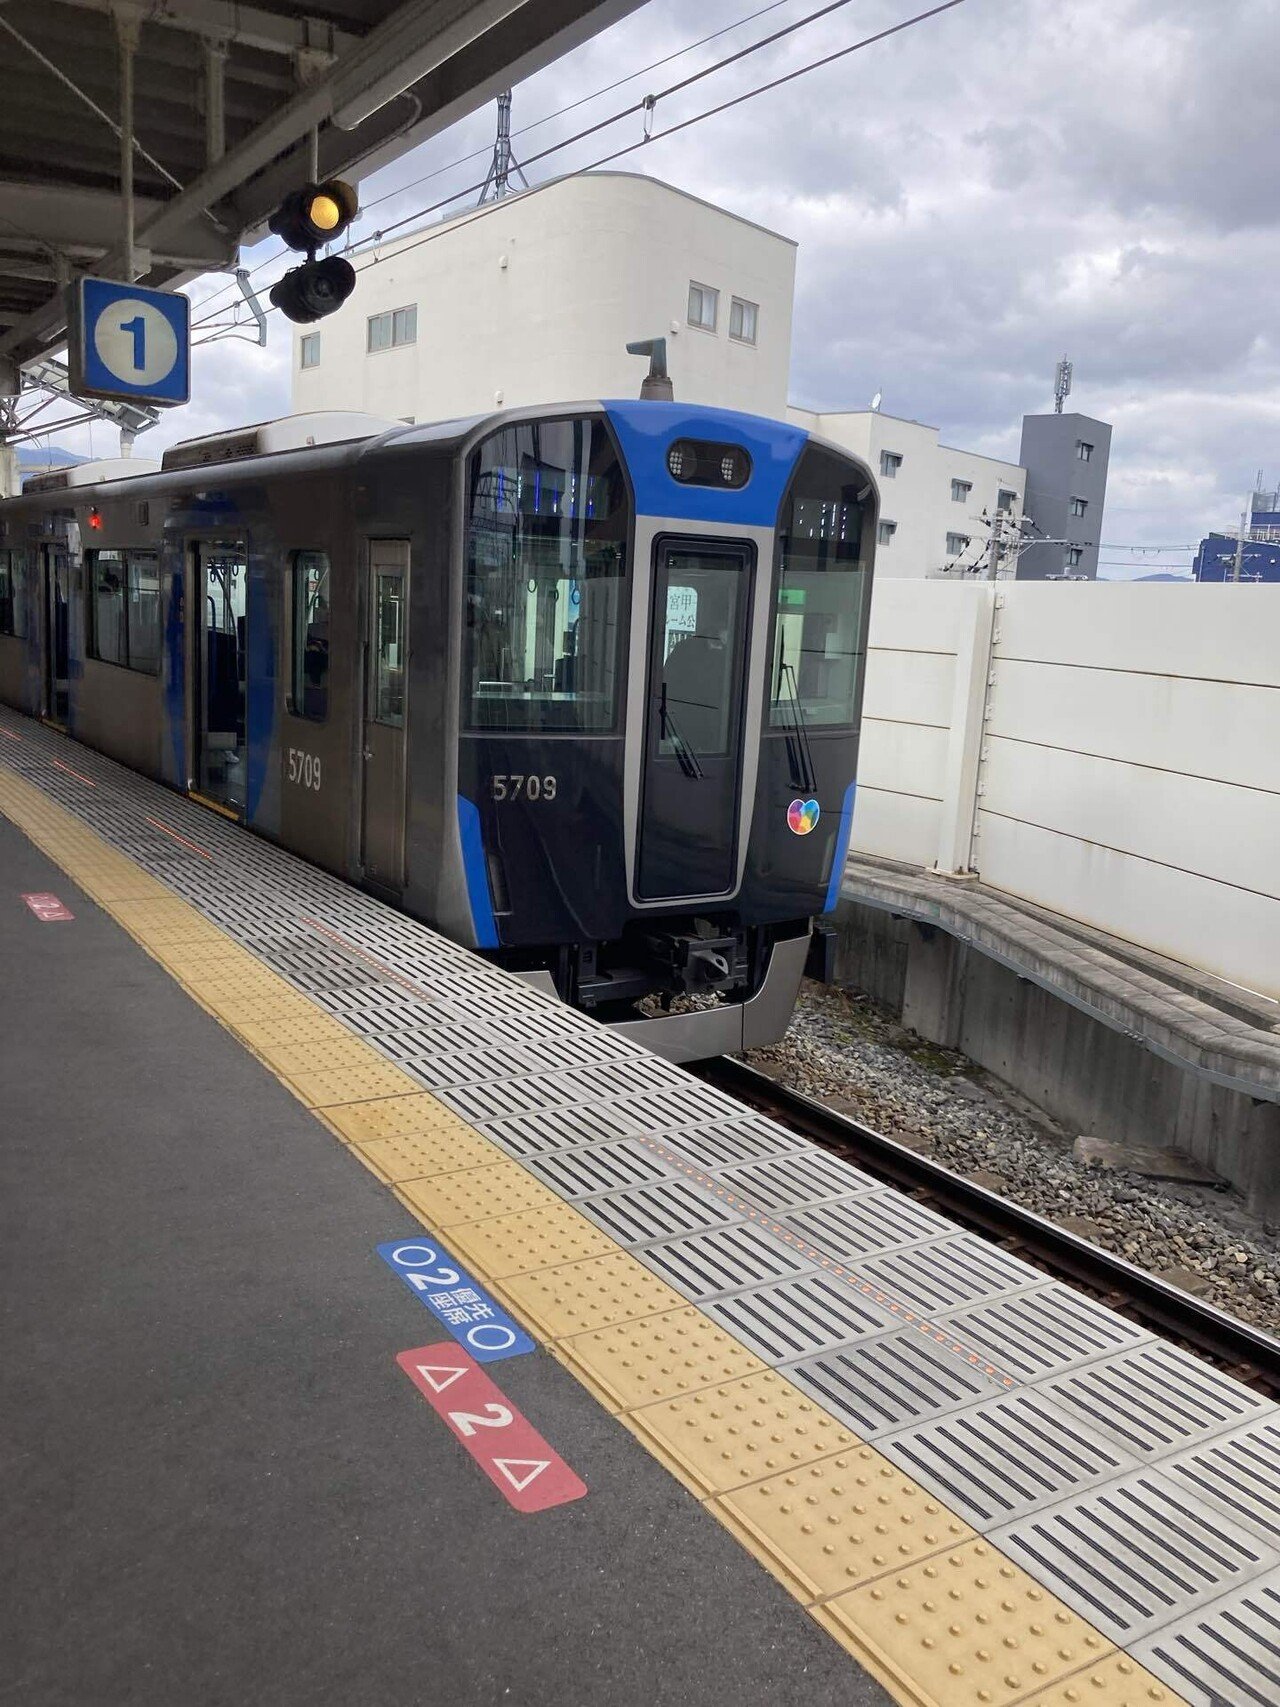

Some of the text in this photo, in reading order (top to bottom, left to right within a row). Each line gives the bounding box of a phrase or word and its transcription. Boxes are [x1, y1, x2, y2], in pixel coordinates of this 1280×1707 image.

[120, 315, 147, 371] 1
[669, 593, 698, 611] 宮甲
[289, 747, 321, 791] 5709
[493, 774, 557, 801] 5709
[406, 1267, 460, 1291] 2
[427, 1292, 474, 1325] 座席
[450, 1288, 495, 1321] 優先
[447, 1403, 514, 1437] 2
